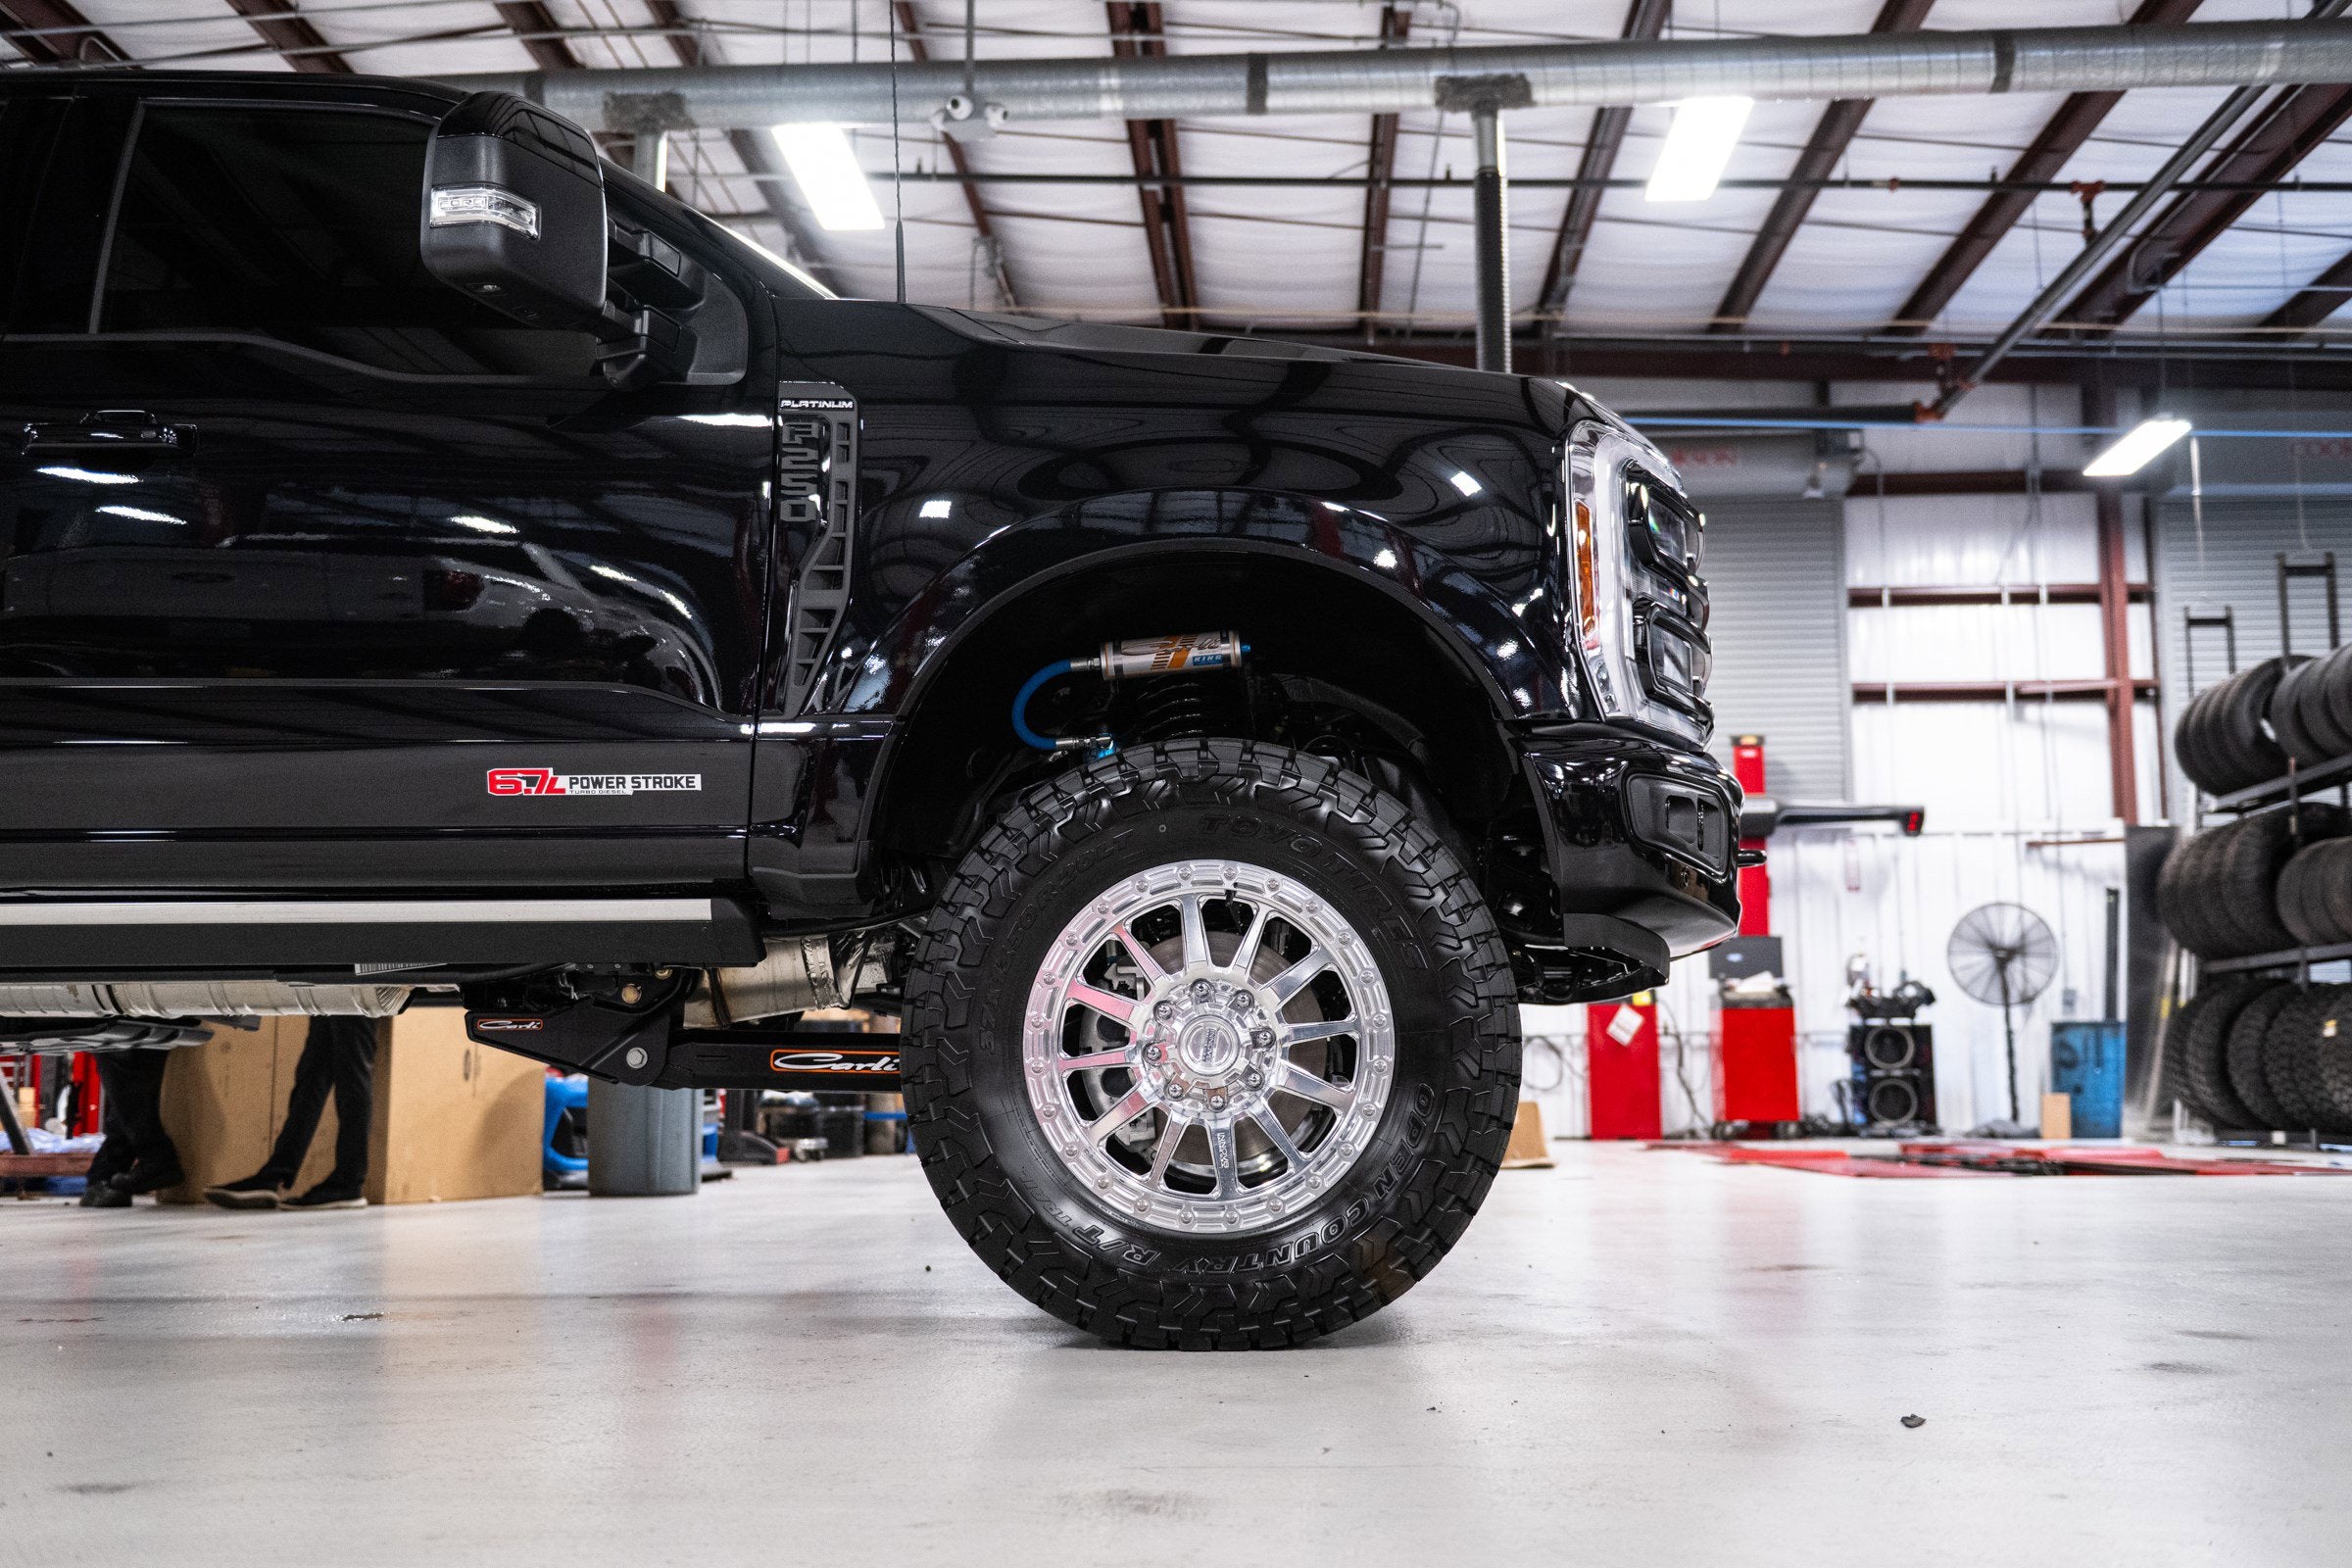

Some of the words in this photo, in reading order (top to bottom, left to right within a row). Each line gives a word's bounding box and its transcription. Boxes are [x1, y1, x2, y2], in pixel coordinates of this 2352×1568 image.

[780, 399, 854, 409] PLATINUM
[780, 421, 819, 522] F250
[488, 768, 566, 796] 6.7L
[568, 776, 626, 790] POWER
[631, 775, 696, 789] STROKE
[1200, 813, 1324, 859] TOYO
[480, 1020, 541, 1029] Carli
[774, 1052, 901, 1071] Carli
[1370, 1081, 1436, 1201] OPEN
[1071, 1222, 1162, 1270] R/T
[1171, 1197, 1370, 1275] COUNTRY
